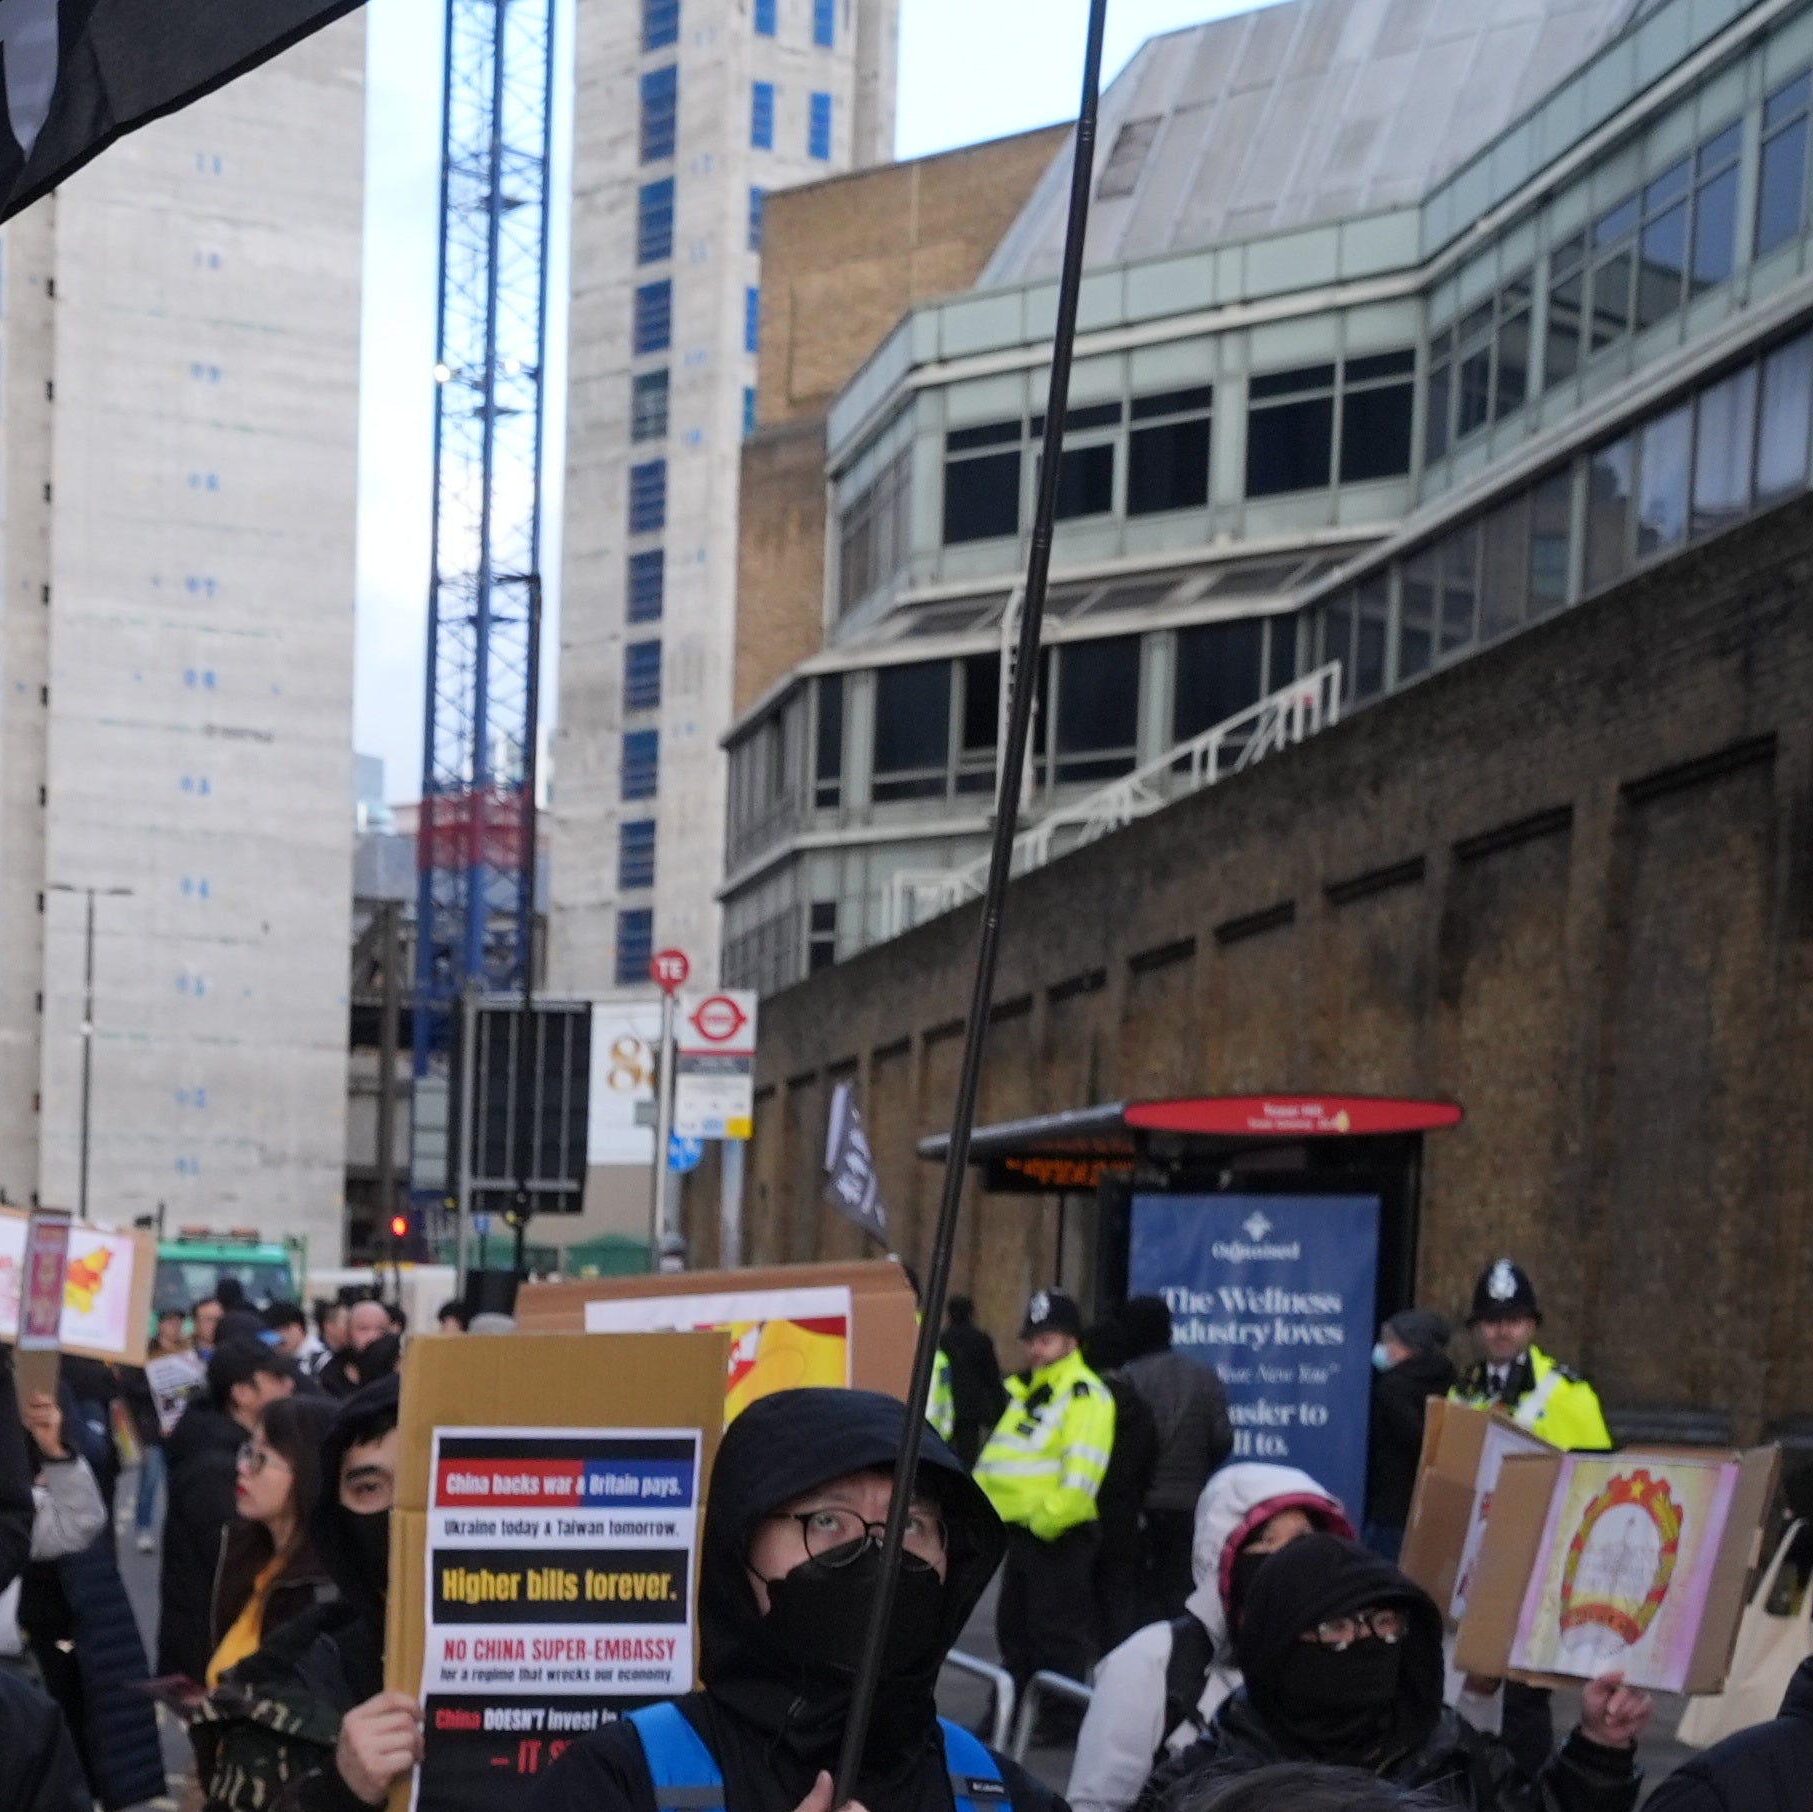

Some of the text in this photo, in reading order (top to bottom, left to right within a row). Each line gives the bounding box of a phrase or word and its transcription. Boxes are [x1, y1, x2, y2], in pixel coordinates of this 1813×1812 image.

[658, 959, 683, 979] TE
[1159, 1285, 1343, 1314] The Wellness
[1171, 1317, 1344, 1351] ndustry loves
[1299, 1401, 1329, 1426] to
[445, 1472, 490, 1496] China
[492, 1473, 540, 1495] backs
[543, 1476, 573, 1495] war
[589, 1474, 640, 1496] Britain
[641, 1476, 681, 1498] pays.
[444, 1519, 497, 1536] Ukraine
[501, 1519, 540, 1539] today
[556, 1520, 604, 1536] Taiwan
[609, 1520, 679, 1537] tomorrow.
[442, 1567, 678, 1604] Higher bills forever.
[444, 1638, 676, 1661] NO CHINA SUPER-EMBASSY
[435, 1708, 482, 1730] China
[483, 1707, 546, 1731] DOESN'T
[547, 1707, 598, 1731] invest
[518, 1740, 542, 1774] IT
